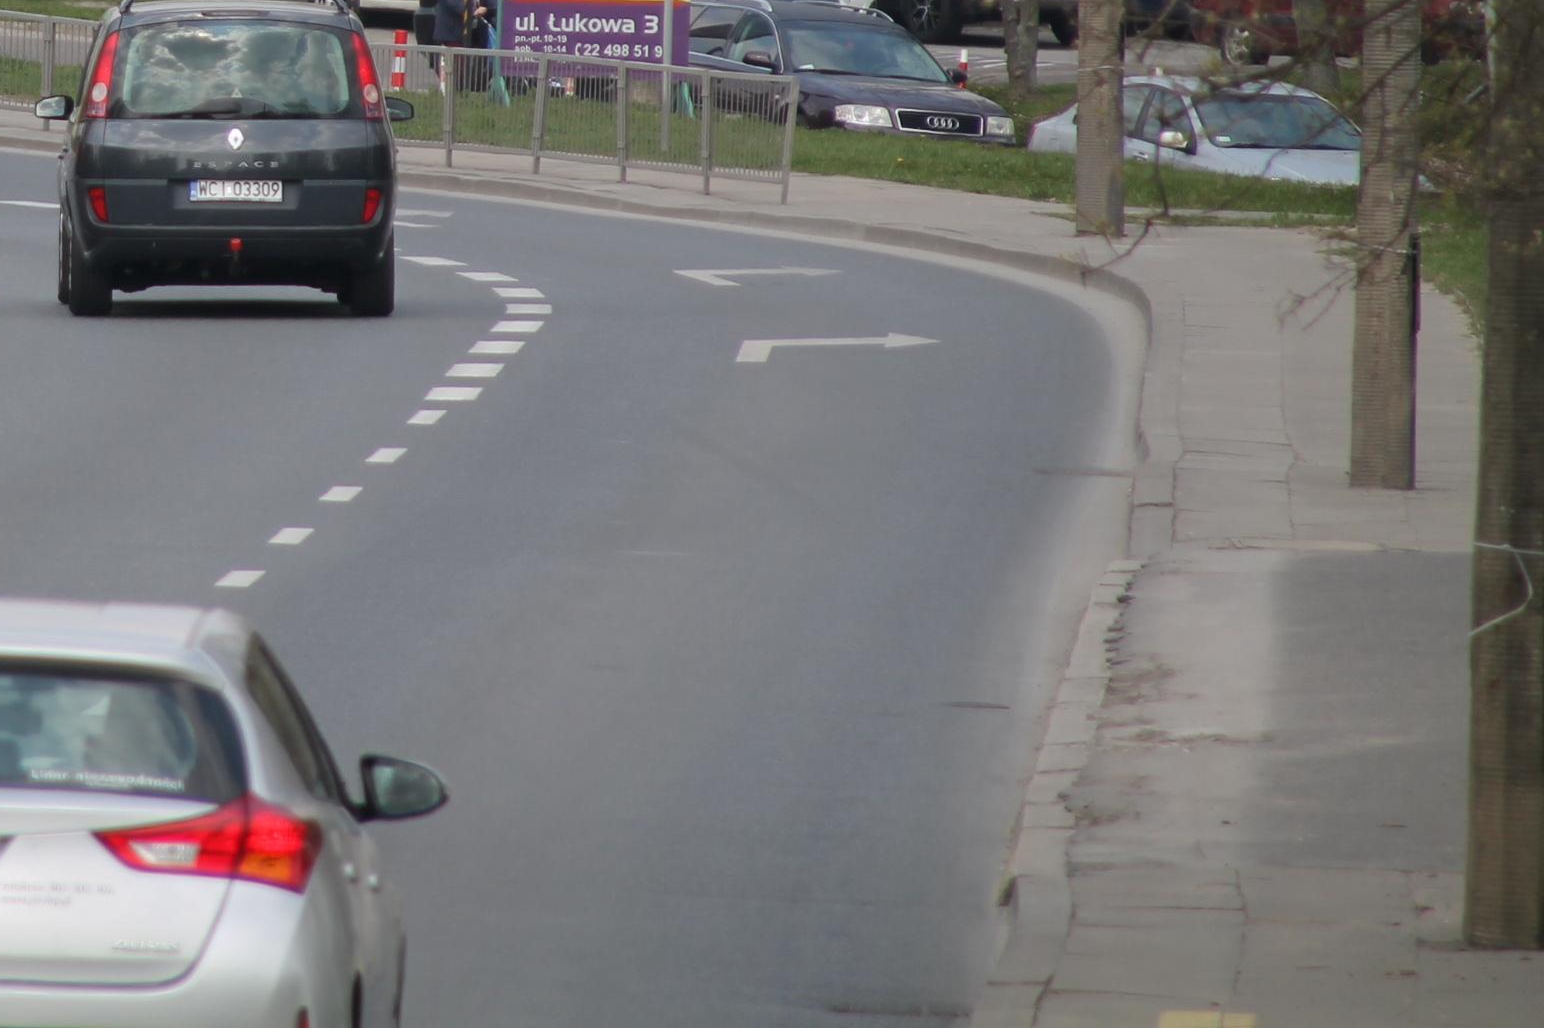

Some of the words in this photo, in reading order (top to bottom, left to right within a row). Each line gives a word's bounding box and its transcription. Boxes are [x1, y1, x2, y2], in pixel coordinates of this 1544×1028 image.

[515, 12, 540, 32] ul.
[547, 12, 636, 34] Łukowa
[643, 15, 660, 34] 3
[543, 35, 568, 44] 10-19
[543, 45, 567, 54] 10-14
[583, 44, 600, 56] 22
[603, 44, 630, 57] 498
[633, 45, 649, 58] 51
[193, 160, 280, 168] ESPACE
[233, 180, 280, 197] 03309
